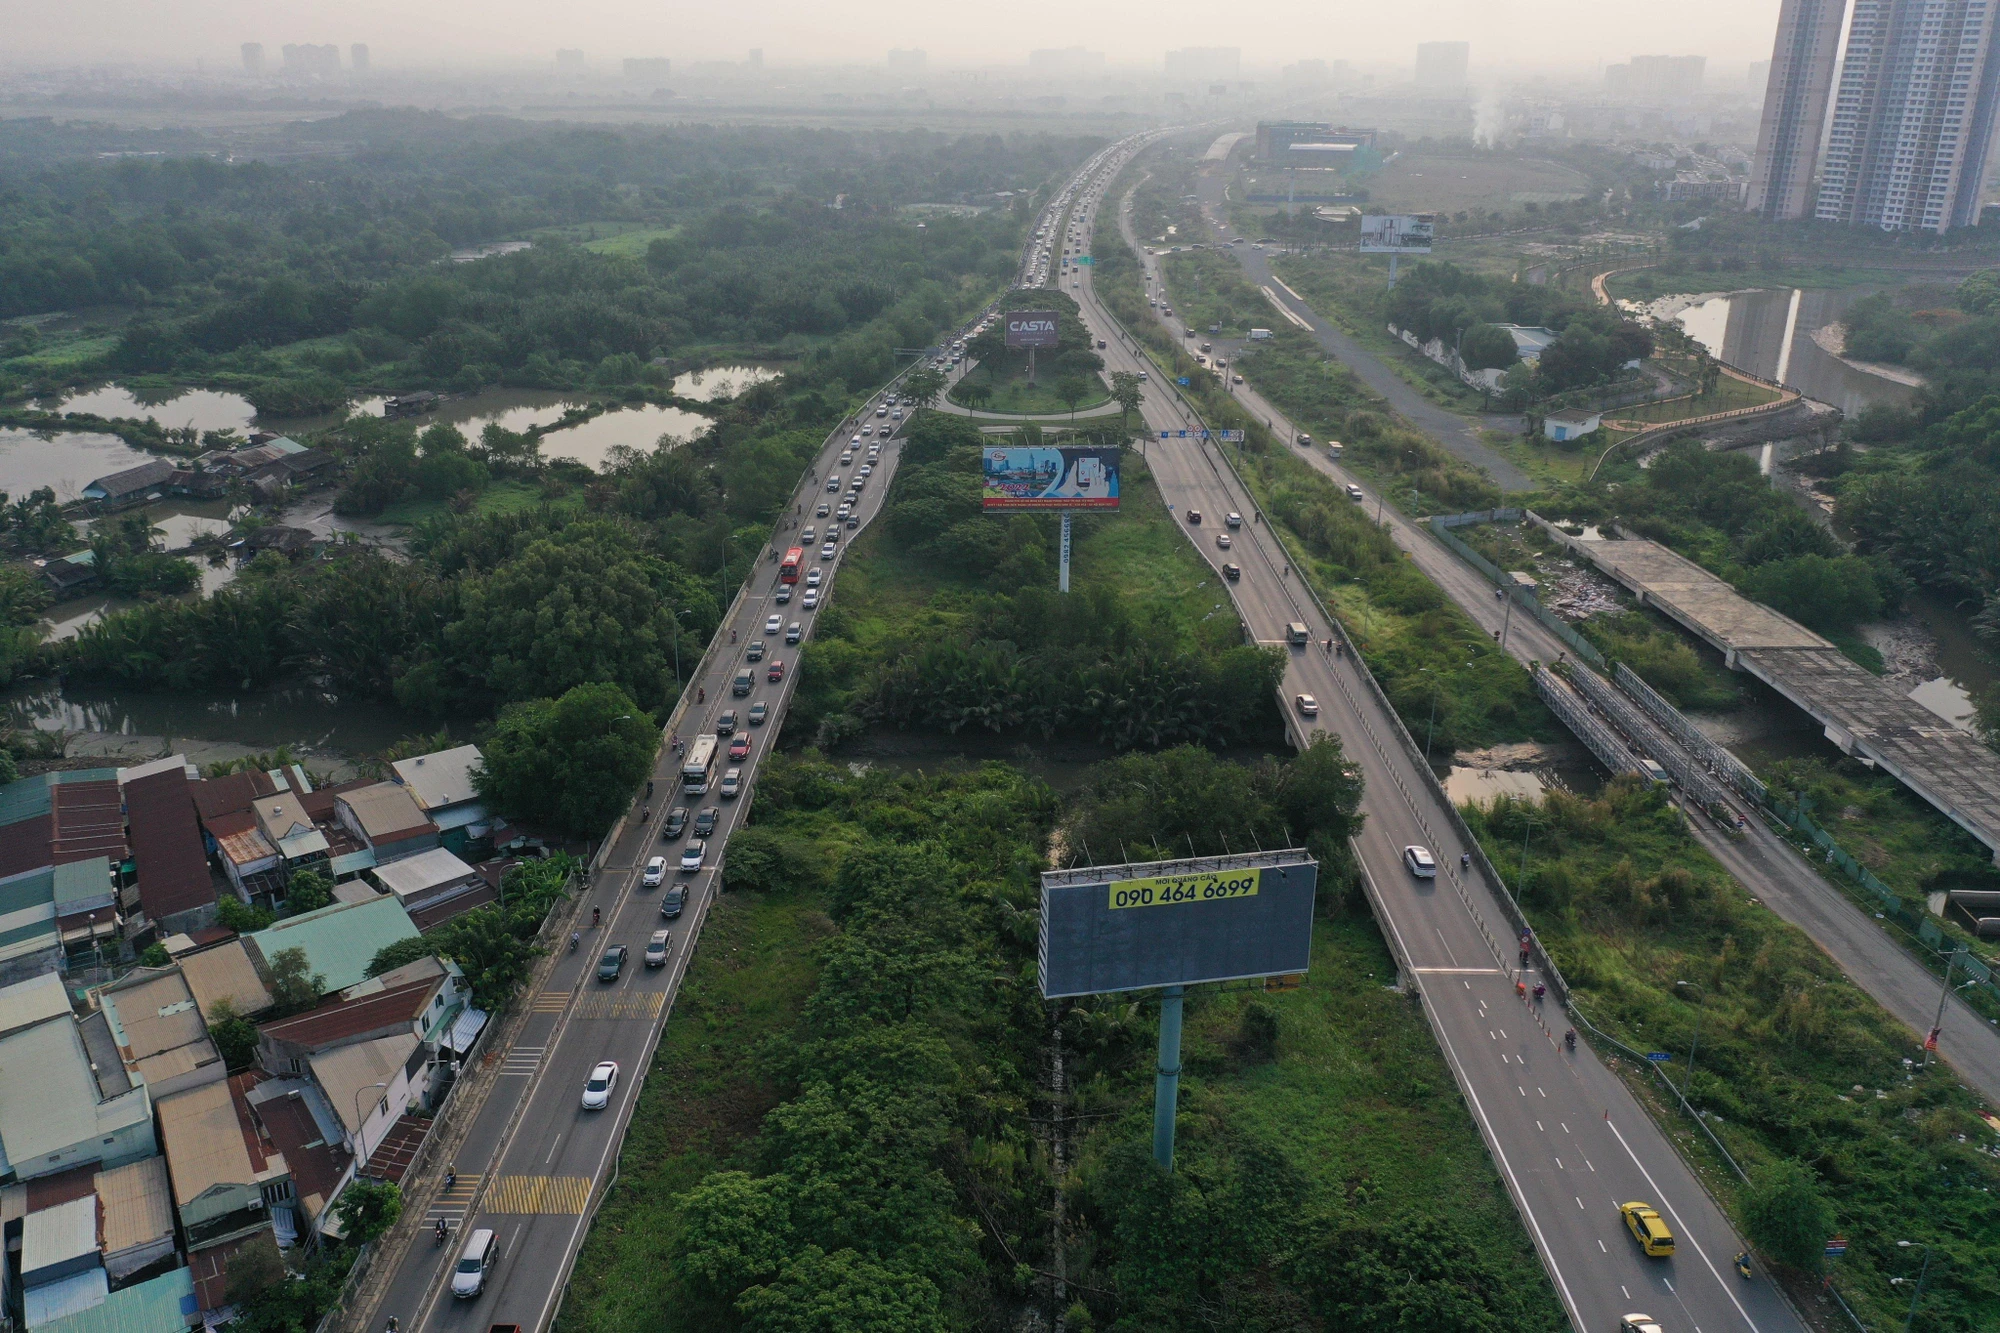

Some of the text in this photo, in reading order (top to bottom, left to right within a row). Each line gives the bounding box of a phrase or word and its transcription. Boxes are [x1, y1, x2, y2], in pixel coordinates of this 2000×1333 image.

[1009, 320, 1055, 332] CASTA
[1116, 879, 1253, 907] 090 464 6699
